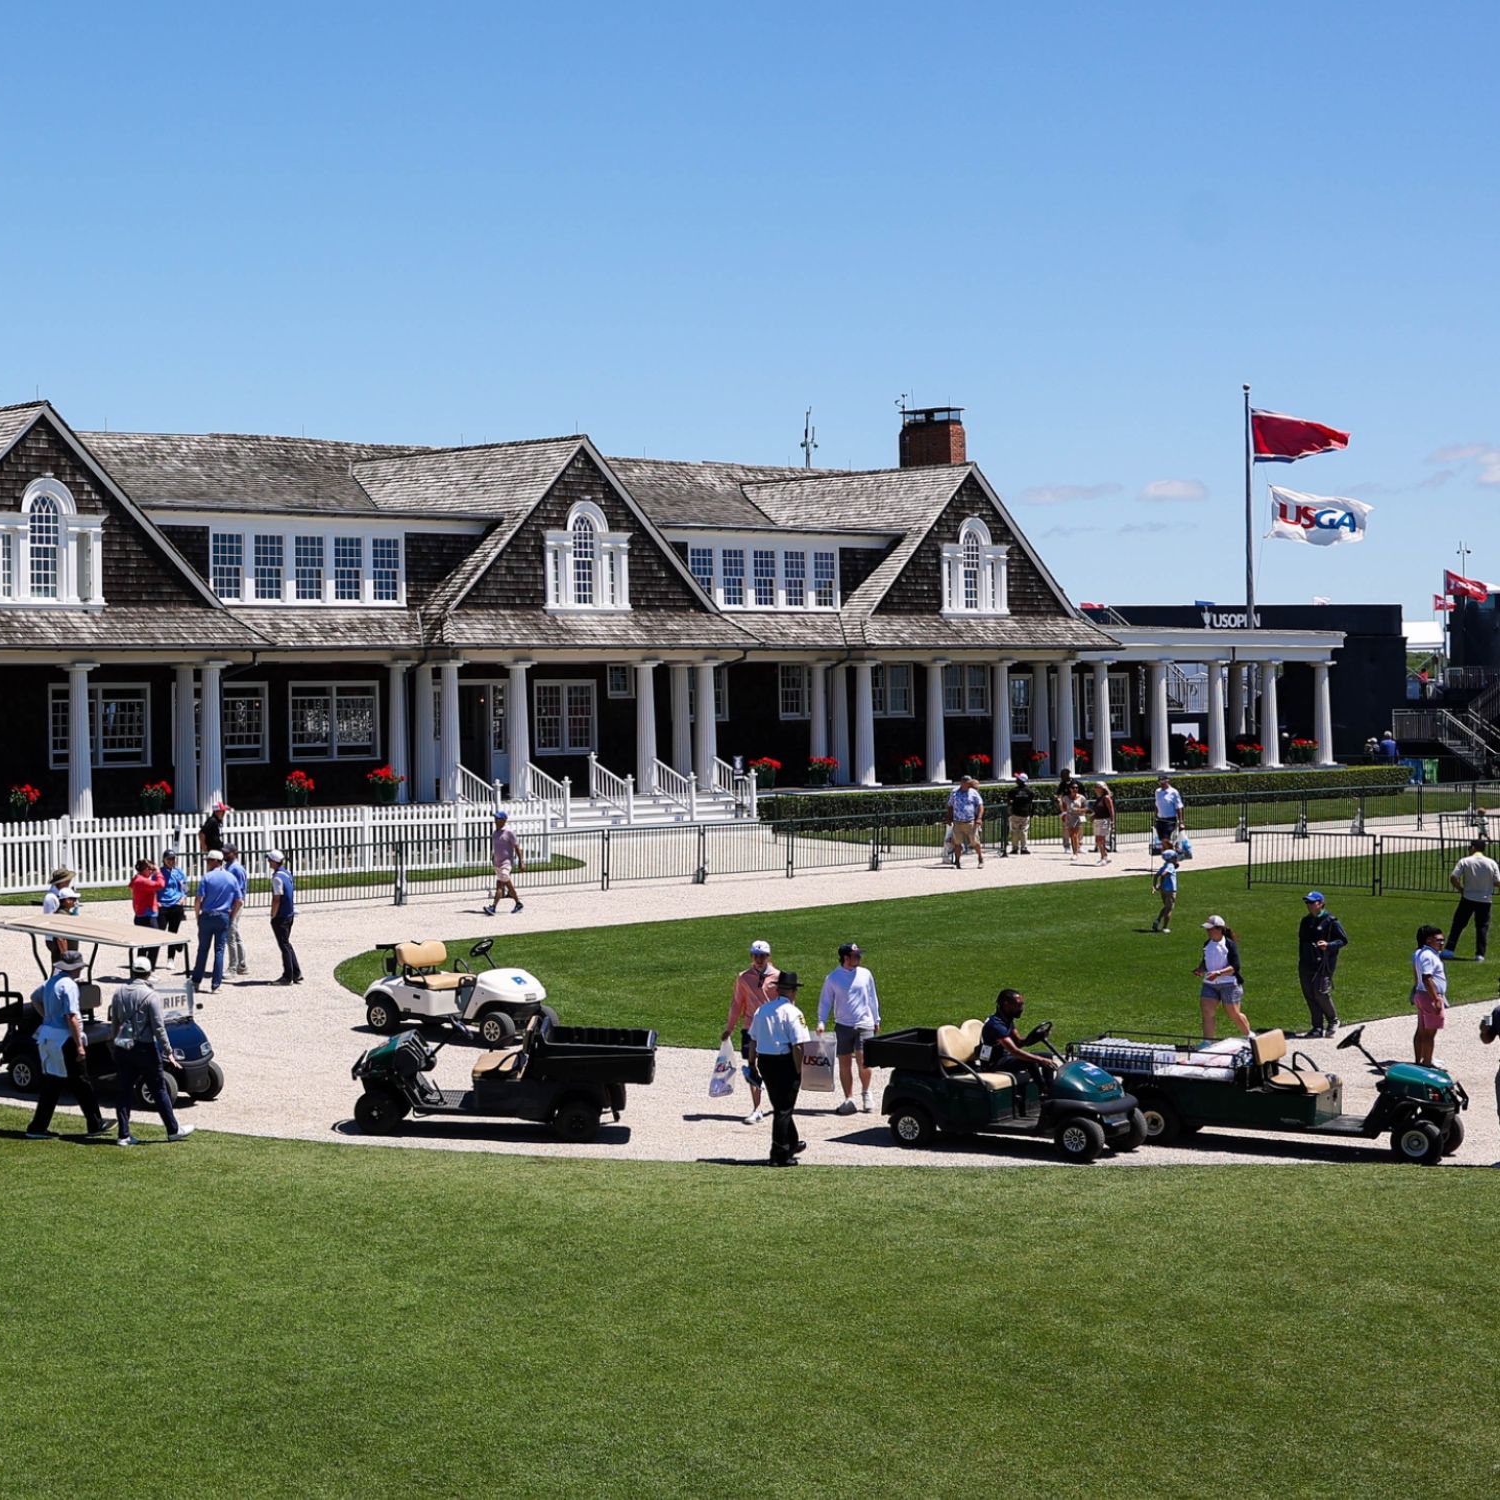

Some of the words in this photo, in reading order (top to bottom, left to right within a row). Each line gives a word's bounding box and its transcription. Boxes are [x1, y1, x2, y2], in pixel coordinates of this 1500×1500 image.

[1279, 502, 1356, 533] USGA
[163, 995, 186, 1009] RIFF
[803, 1056, 831, 1067] USGA
